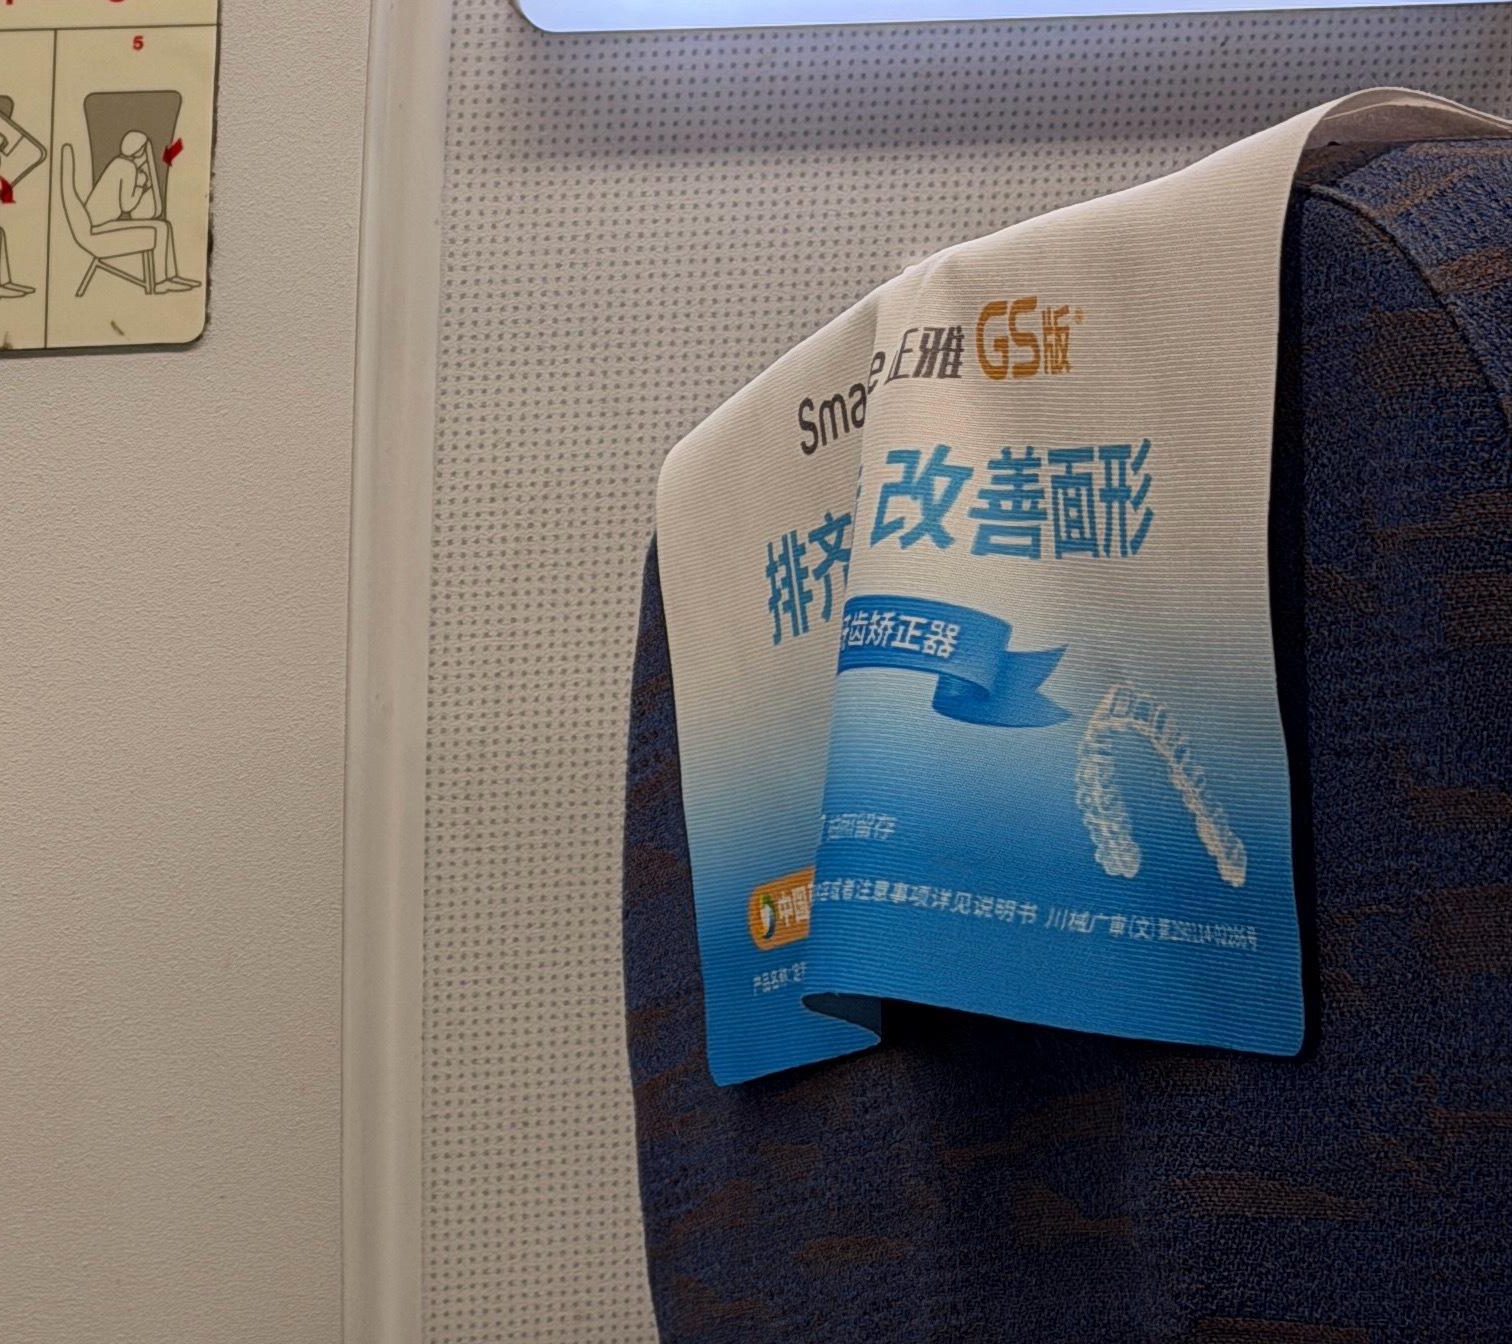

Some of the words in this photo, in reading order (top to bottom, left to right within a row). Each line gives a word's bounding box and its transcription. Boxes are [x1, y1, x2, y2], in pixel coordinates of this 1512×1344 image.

[132, 34, 145, 51] 5
[869, 437, 1155, 560] 改善面形
